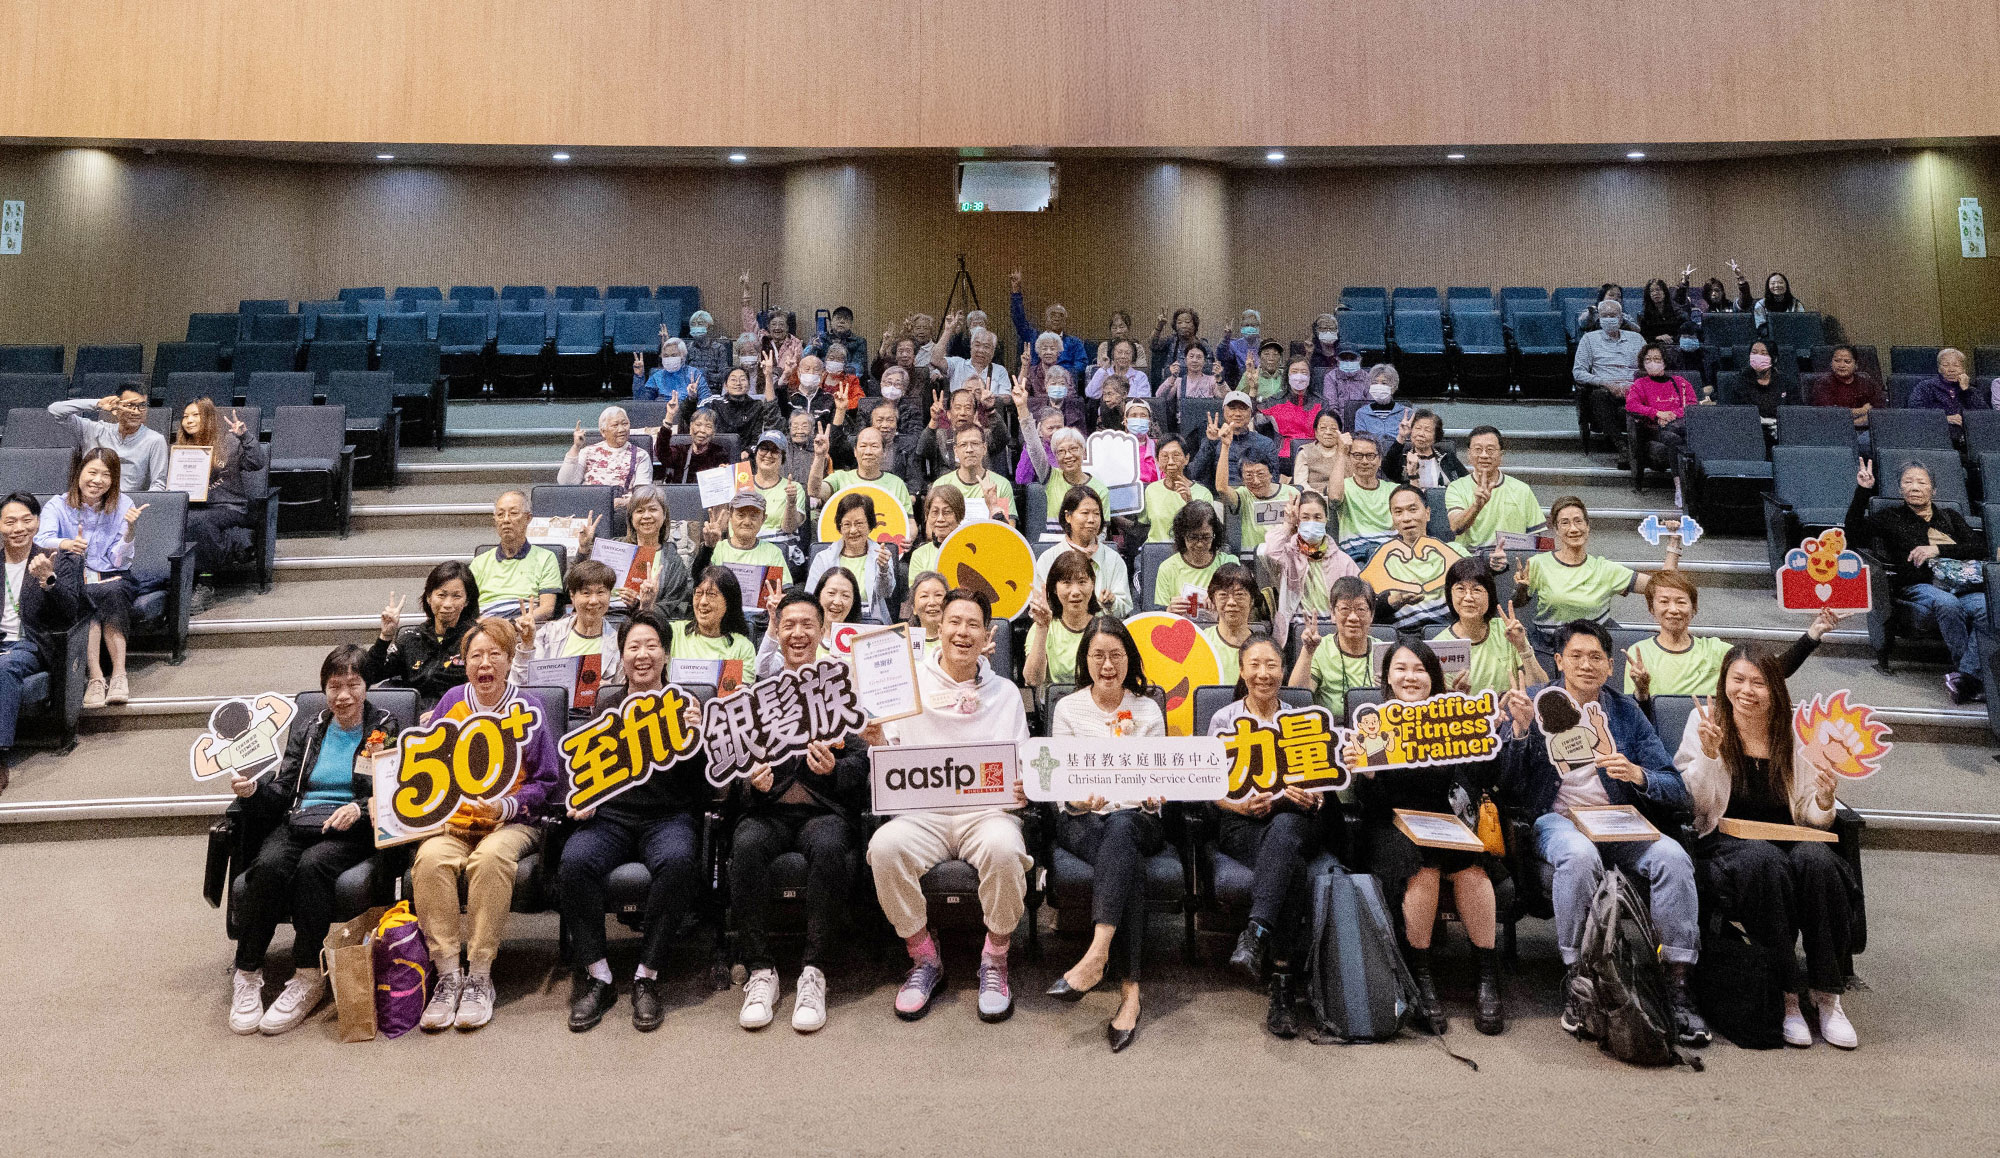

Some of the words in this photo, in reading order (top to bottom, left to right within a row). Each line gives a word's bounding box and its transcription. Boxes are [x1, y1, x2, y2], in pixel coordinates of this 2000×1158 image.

[961, 201, 984, 212] 10:38
[706, 663, 859, 777] 銀髮族
[1386, 693, 1492, 723] Certified
[1401, 718, 1488, 741] Fitness
[396, 704, 533, 818] 50+
[1066, 752, 1220, 767] 基督教家庭服務中心
[1219, 712, 1339, 792] 力量
[1402, 737, 1495, 760] Trainer
[885, 757, 976, 794] aasfp
[1068, 774, 1112, 784] Christian
[1114, 774, 1147, 786] Family
[1150, 774, 1186, 784] Service
[1188, 774, 1221, 784] Centre
